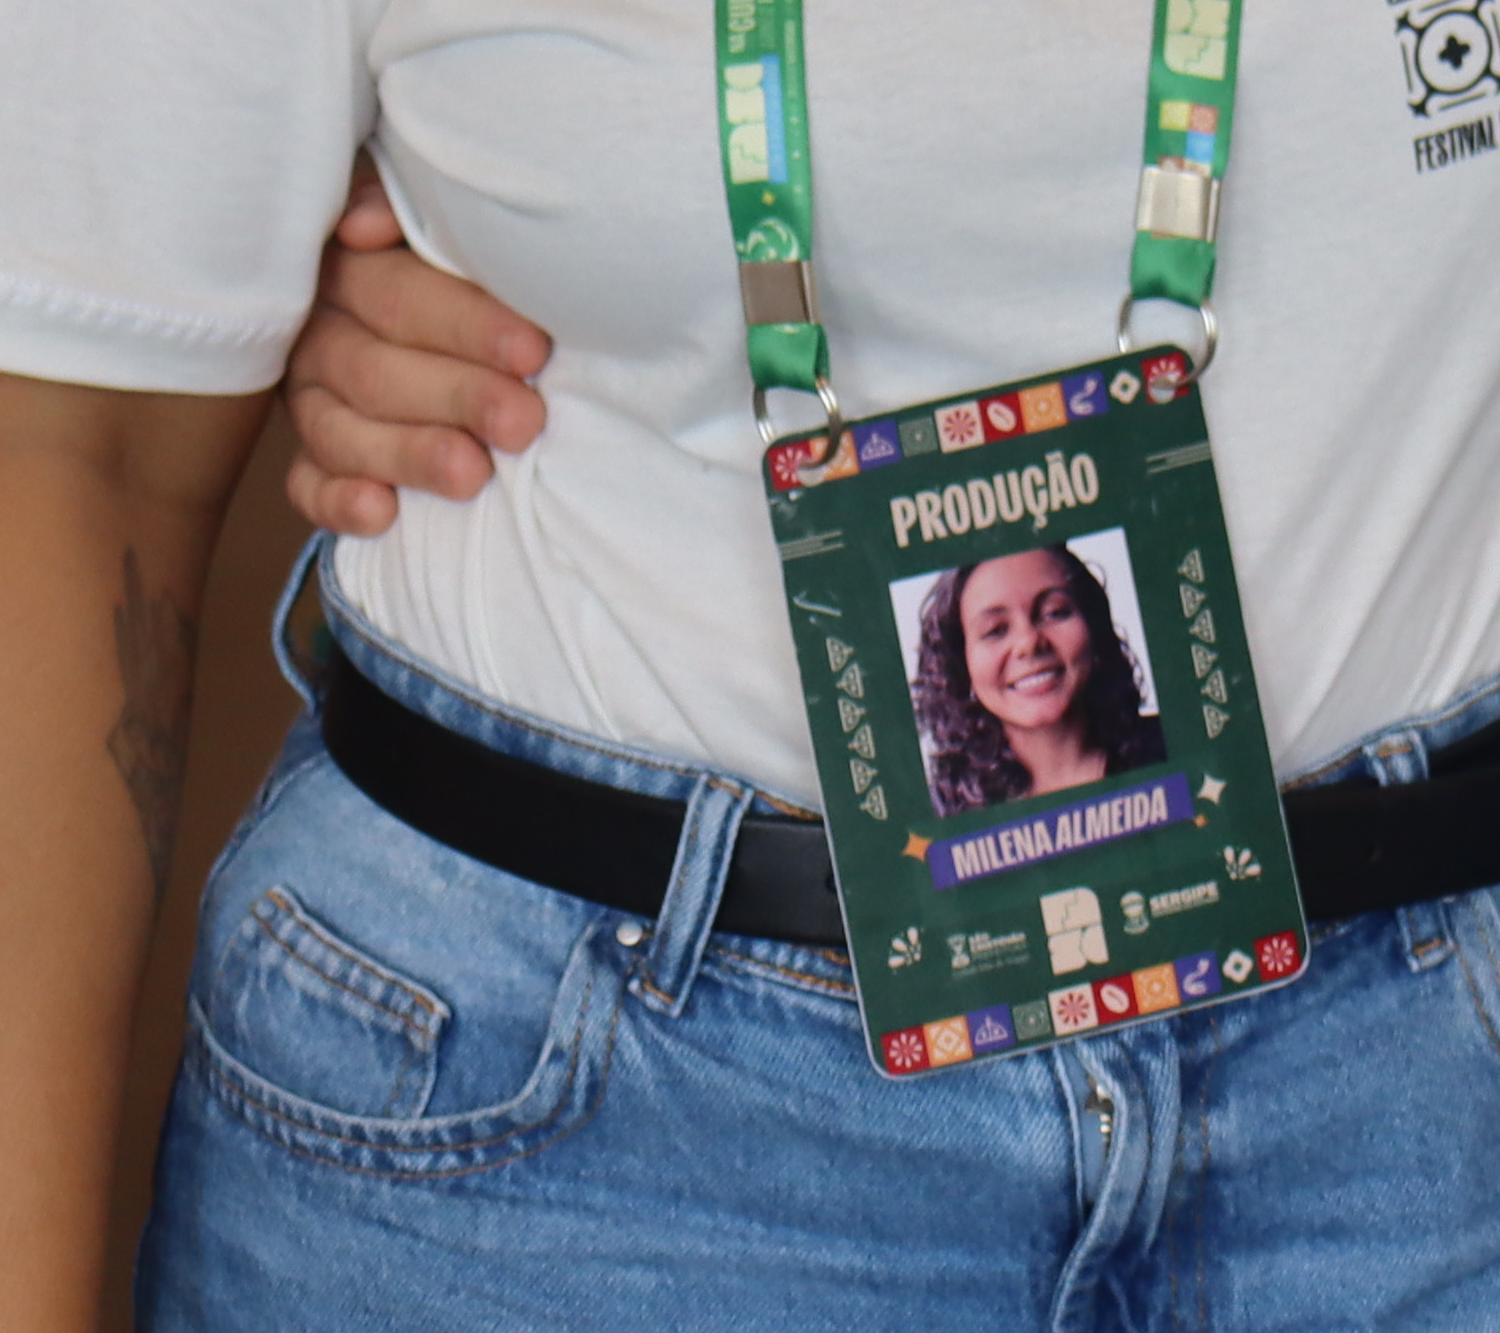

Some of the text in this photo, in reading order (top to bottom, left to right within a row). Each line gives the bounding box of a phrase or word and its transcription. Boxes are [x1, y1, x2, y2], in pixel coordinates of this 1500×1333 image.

[1413, 114, 1497, 173] FESTIVAL
[890, 450, 1099, 548] PRODUÇÃO
[950, 784, 1170, 881] MILENA ALMEIDA
